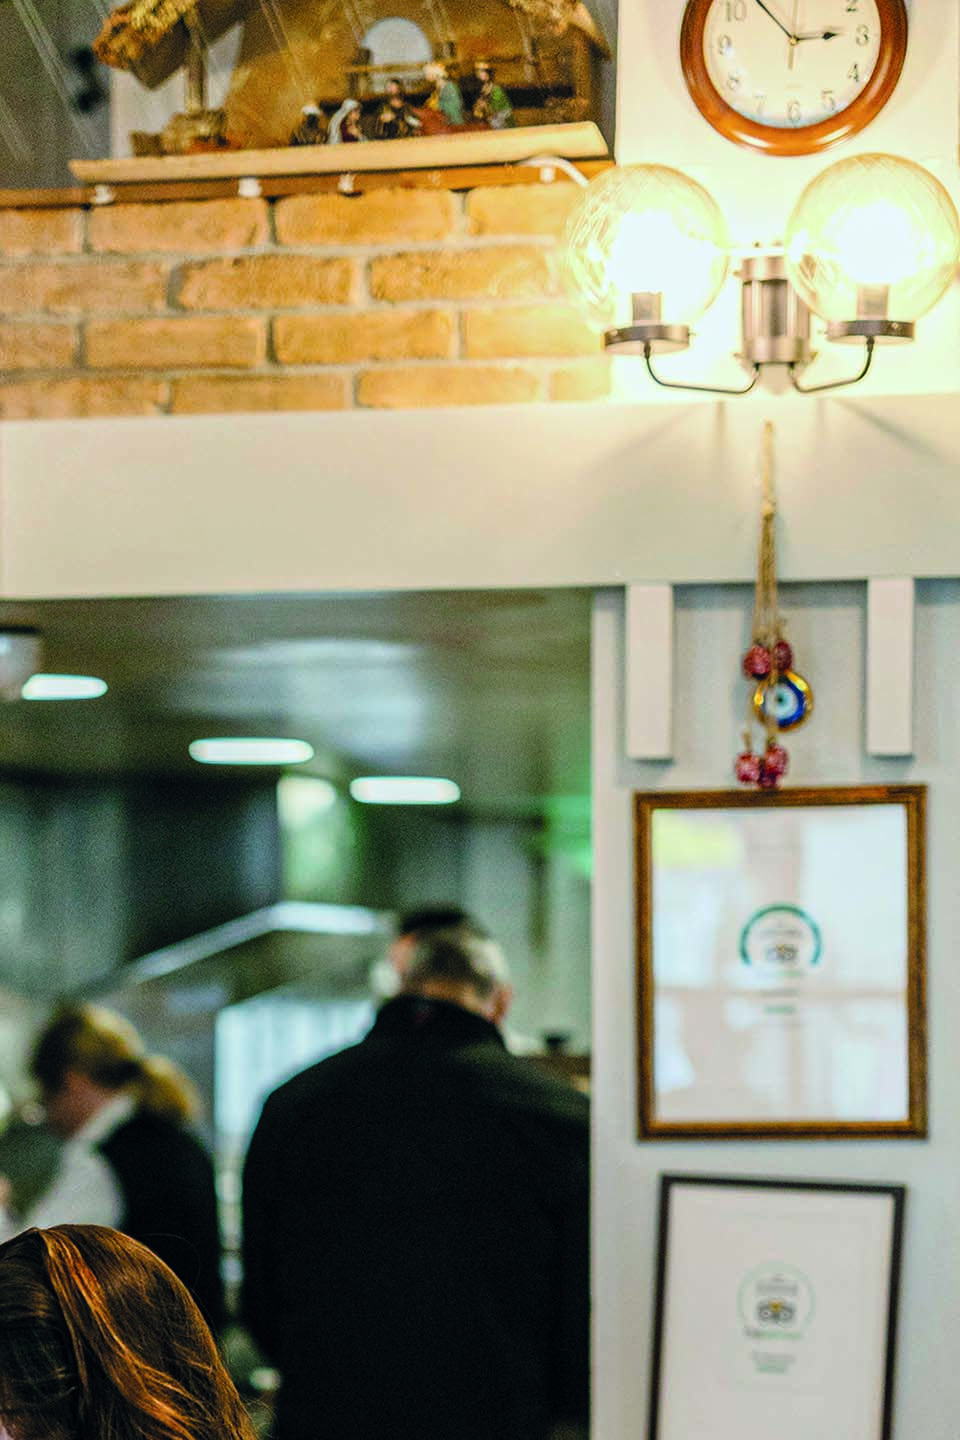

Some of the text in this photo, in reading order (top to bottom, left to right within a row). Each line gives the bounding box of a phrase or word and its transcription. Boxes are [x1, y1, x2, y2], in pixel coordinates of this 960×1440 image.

[855, 24, 869, 47] 3
[847, 63, 859, 82] 4
[785, 100, 800, 122] 6
[821, 90, 836, 111] 5
